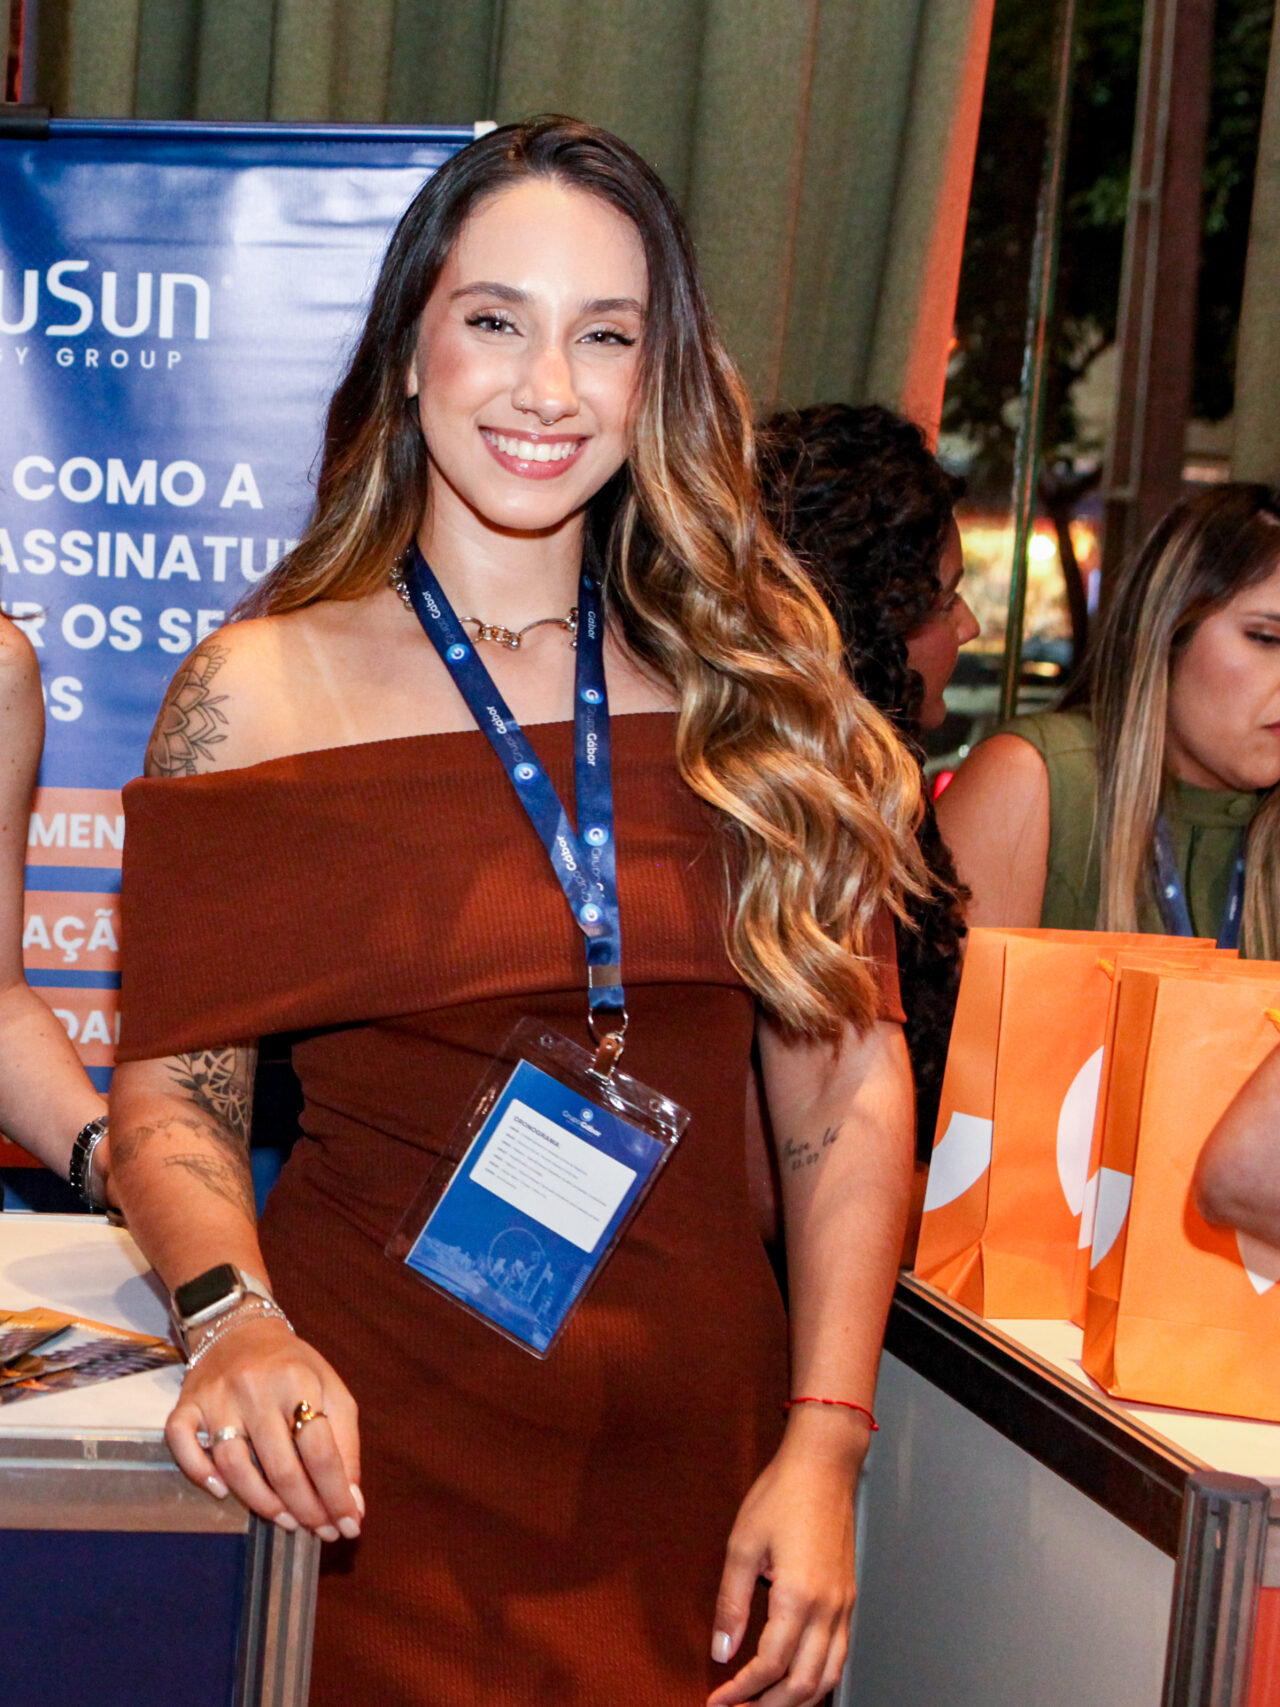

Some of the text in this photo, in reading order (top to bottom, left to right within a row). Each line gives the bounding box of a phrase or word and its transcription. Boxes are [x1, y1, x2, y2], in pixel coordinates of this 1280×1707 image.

[56, 347, 182, 370] GROUP
[12, 455, 206, 507] COMO
[219, 463, 264, 509] A
[61, 603, 143, 652] OS
[27, 812, 125, 851] MEN
[22, 908, 119, 963] AÇÃ
